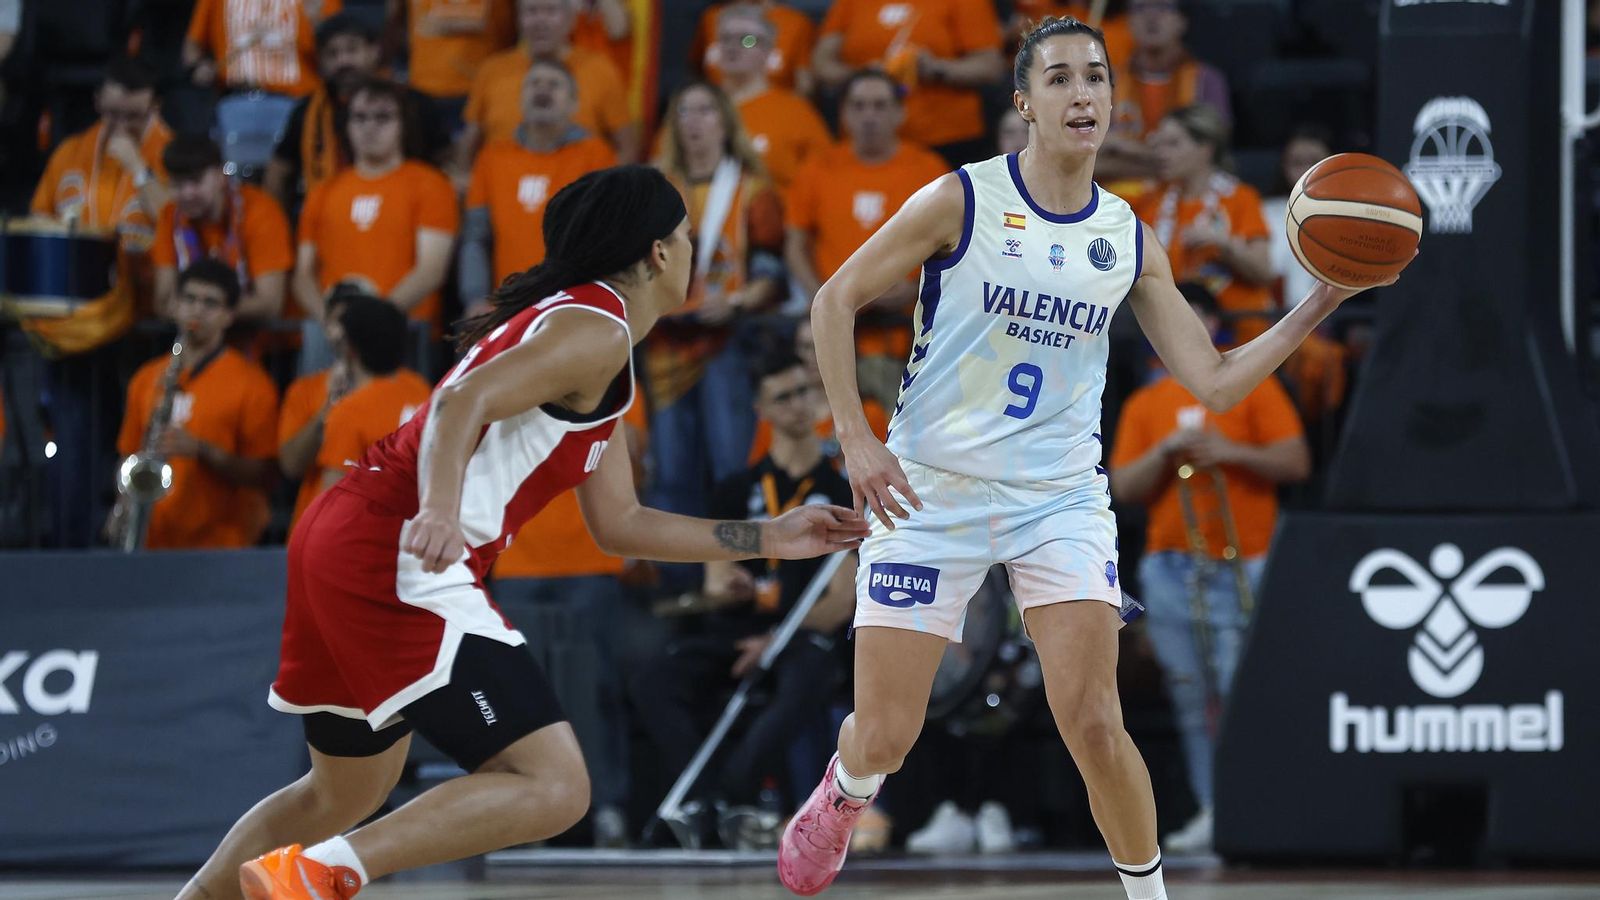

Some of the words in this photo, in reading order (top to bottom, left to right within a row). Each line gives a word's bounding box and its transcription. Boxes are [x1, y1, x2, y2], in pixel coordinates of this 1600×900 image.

[983, 281, 1109, 336] VALENCIA
[1006, 321, 1076, 350] BASKET
[1003, 362, 1043, 420] 9
[871, 572, 931, 593] PULEVA
[470, 691, 498, 727] TECHFIT
[1329, 689, 1564, 753] hummel
